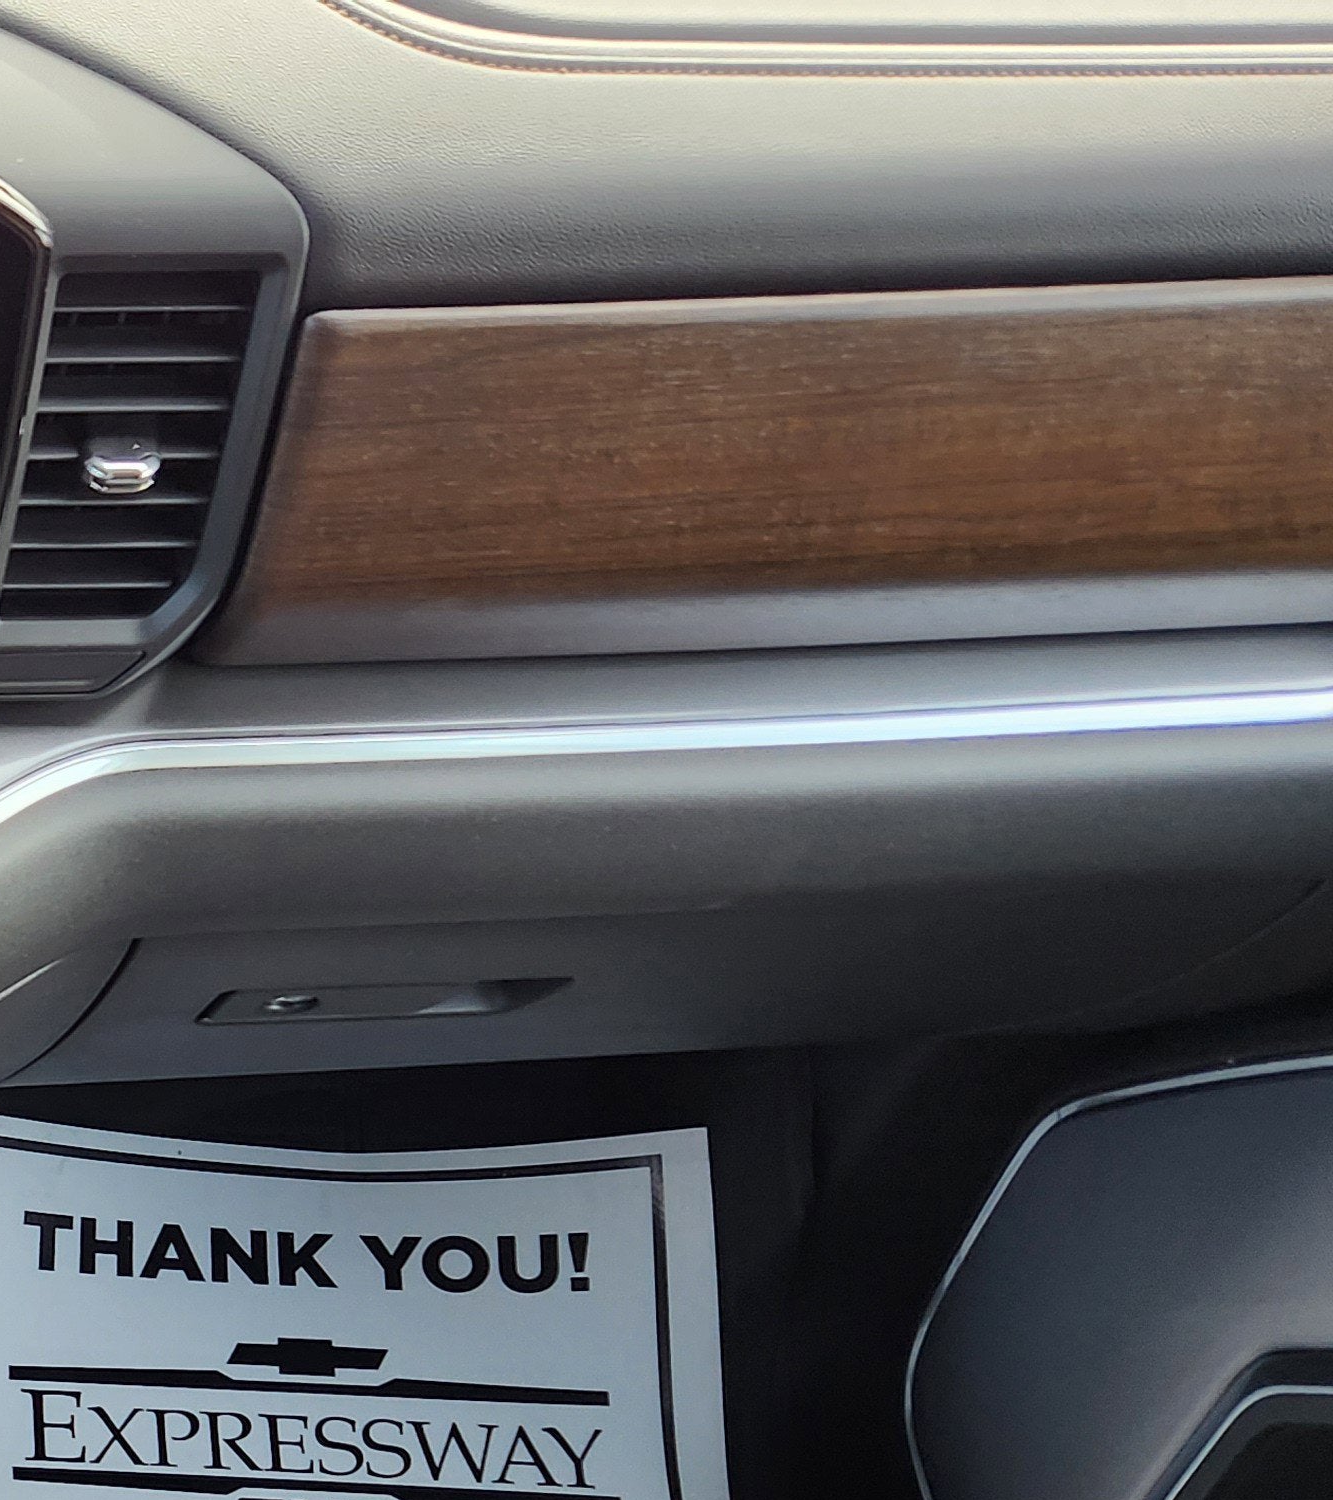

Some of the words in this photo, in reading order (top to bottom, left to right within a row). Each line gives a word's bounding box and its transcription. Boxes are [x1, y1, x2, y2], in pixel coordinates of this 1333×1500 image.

[23, 1209, 340, 1288] THANK
[360, 1230, 590, 1294] YOU!
[20, 1387, 604, 1490] EXPRESSWAY
